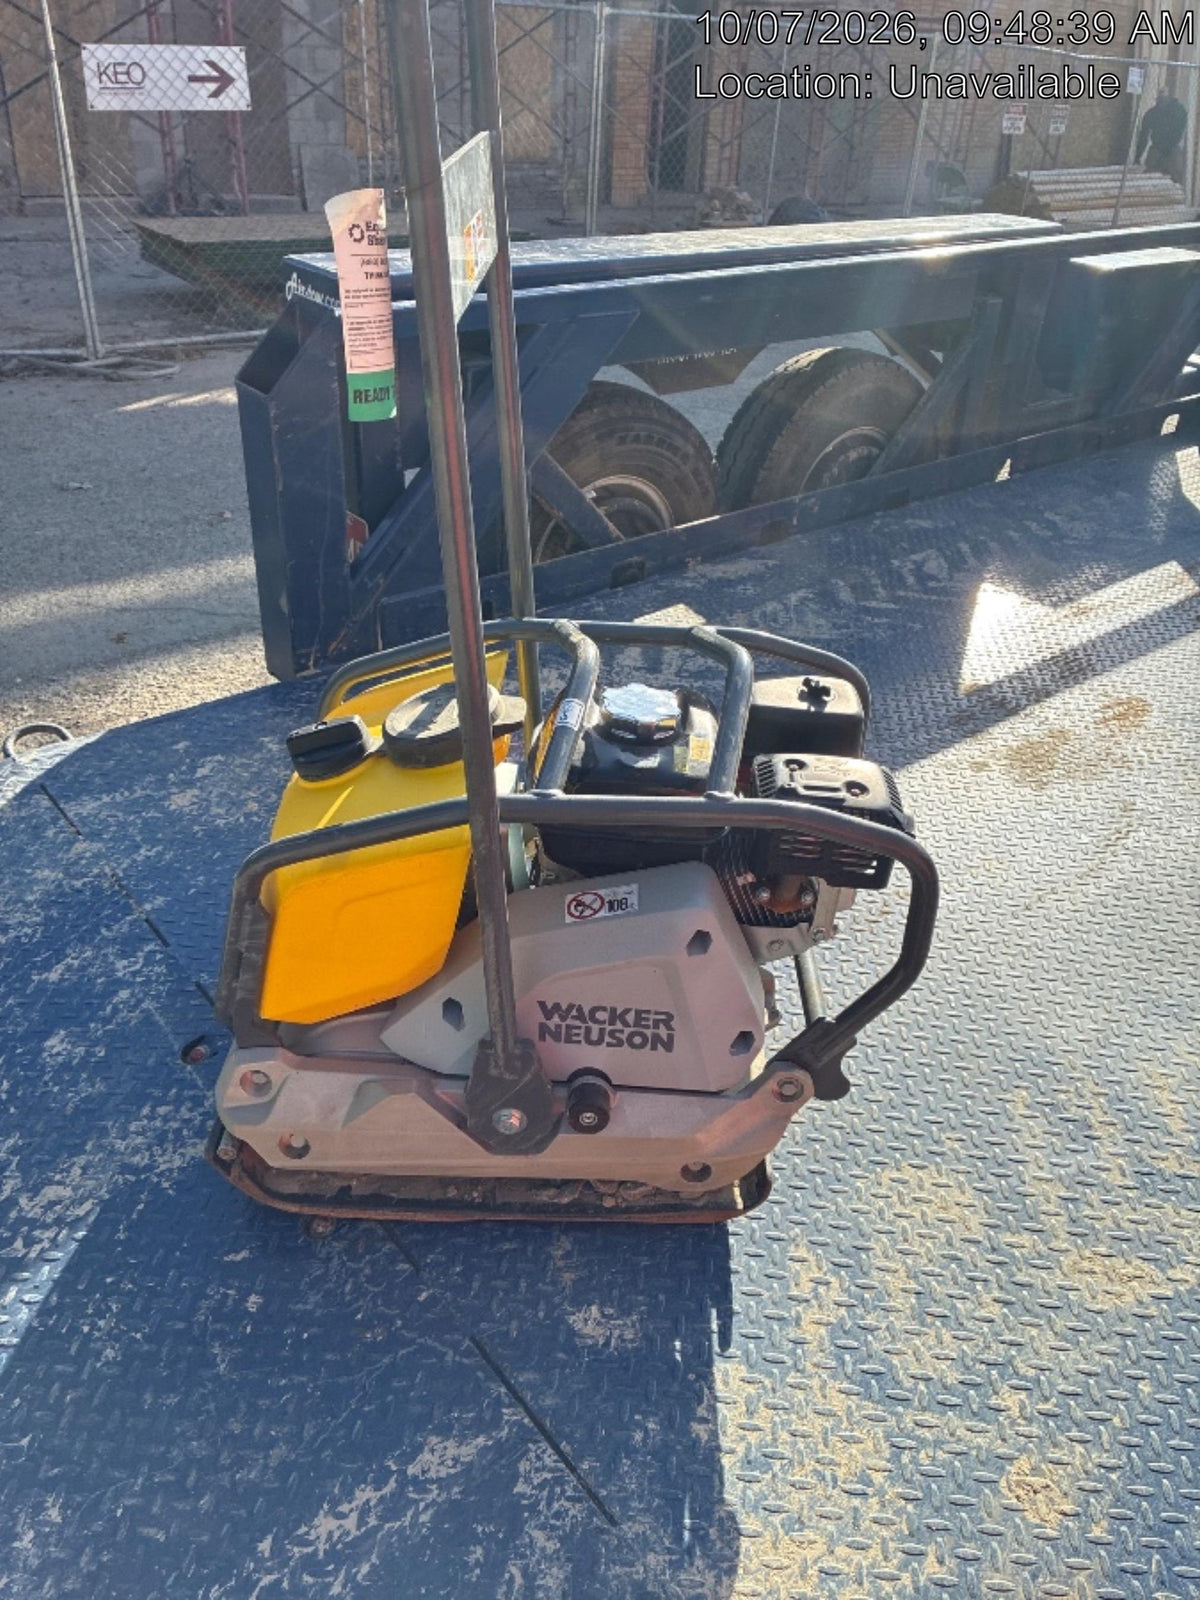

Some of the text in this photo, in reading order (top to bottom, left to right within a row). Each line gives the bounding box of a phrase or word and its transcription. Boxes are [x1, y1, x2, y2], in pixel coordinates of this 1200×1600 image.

[97, 62, 146, 85] KEO
[536, 1000, 675, 1031] WACKER
[538, 1022, 675, 1053] NEUSON
